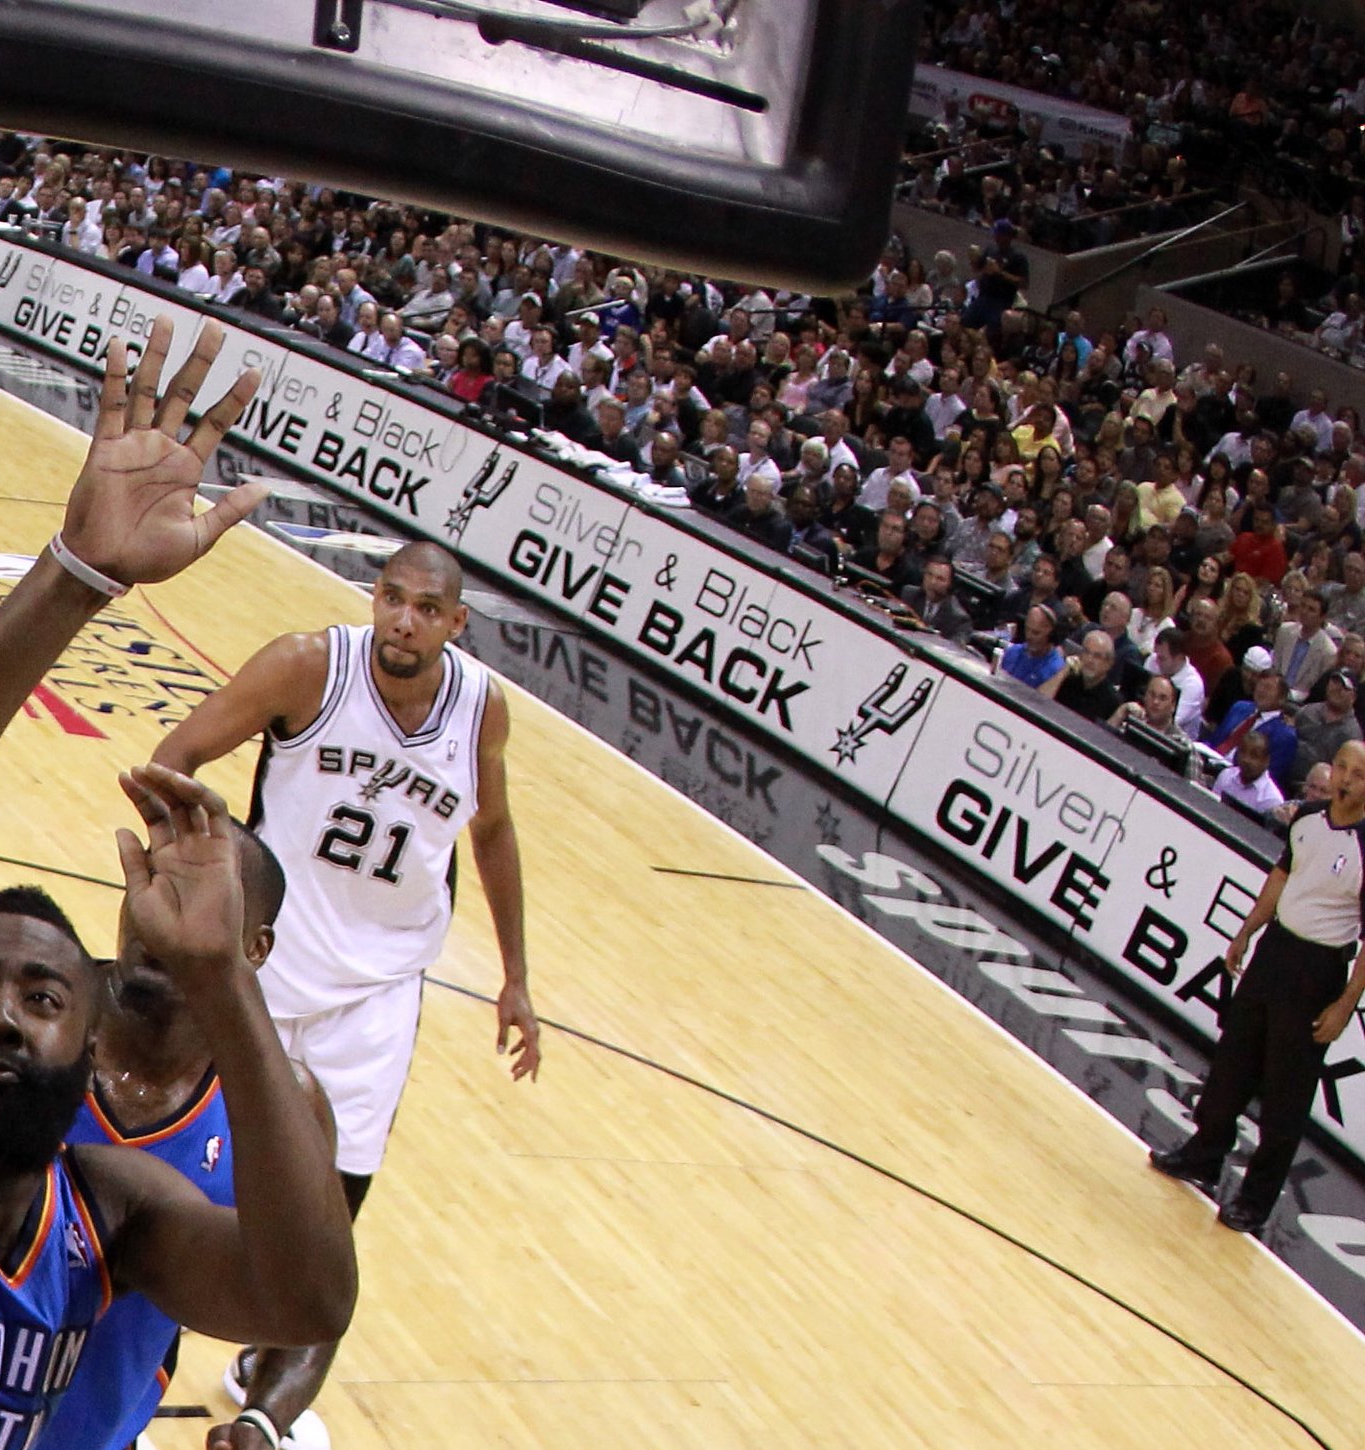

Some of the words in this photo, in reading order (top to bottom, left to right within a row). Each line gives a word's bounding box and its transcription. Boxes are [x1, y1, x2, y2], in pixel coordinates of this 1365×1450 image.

[13, 297, 76, 346] GIVE
[26, 264, 84, 305] Silver
[89, 292, 103, 317] &
[109, 296, 155, 338] Blac
[234, 397, 309, 454] IVE
[312, 430, 431, 516] BACK
[325, 391, 342, 424] &
[354, 399, 441, 468] Black
[529, 482, 643, 564] Silver
[655, 552, 678, 592] &
[695, 567, 823, 671] Black
[508, 528, 632, 627] GIVE
[638, 599, 811, 733] BACK
[318, 745, 461, 822] SPURS
[966, 720, 1127, 844] Silver
[1145, 846, 1179, 899] &
[314, 800, 416, 888] 21
[935, 778, 1112, 932] GIVE
